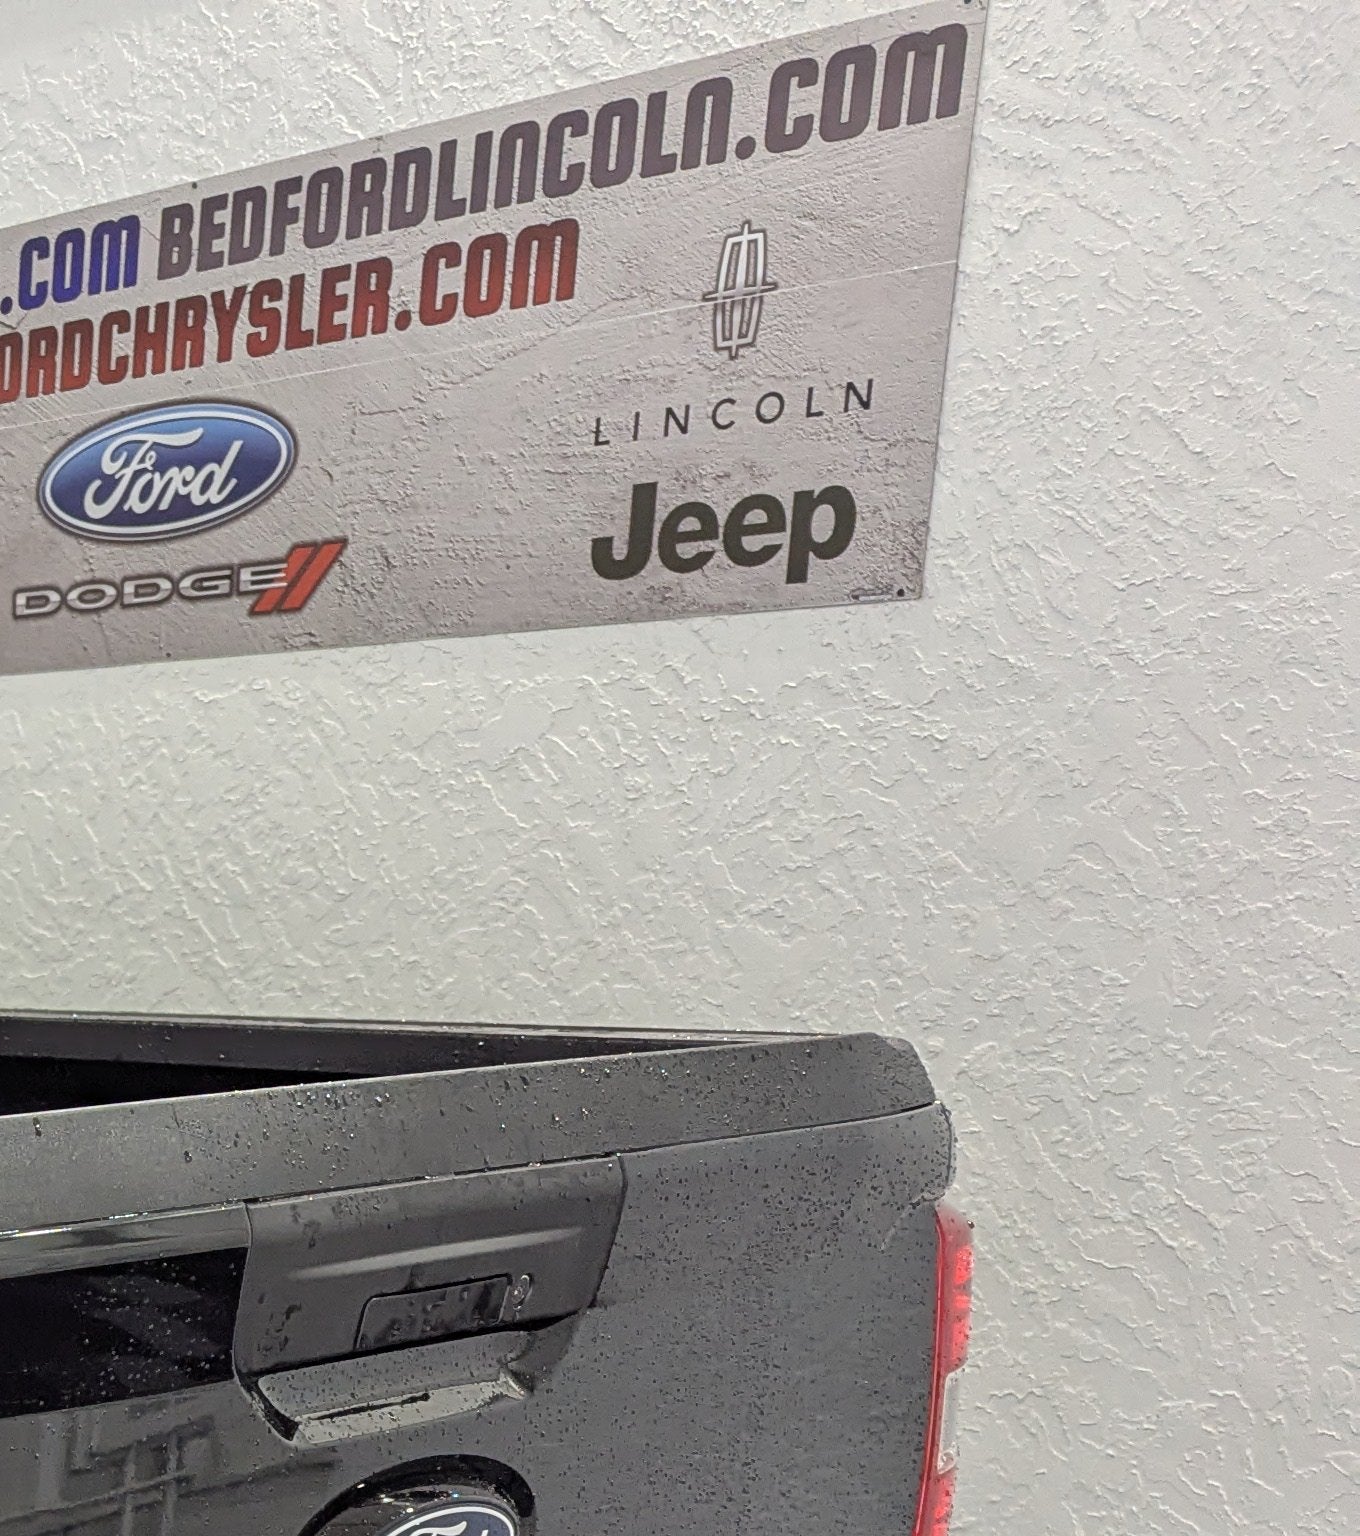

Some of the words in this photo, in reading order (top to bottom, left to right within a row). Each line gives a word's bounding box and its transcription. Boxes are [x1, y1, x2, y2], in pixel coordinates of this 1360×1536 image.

[156, 22, 969, 281] BEDFORDLINCOLN.COM
[592, 378, 875, 447] LINCOLN
[85, 427, 243, 520] Ford
[590, 481, 857, 585] Jeep
[13, 560, 289, 620] DODGE
